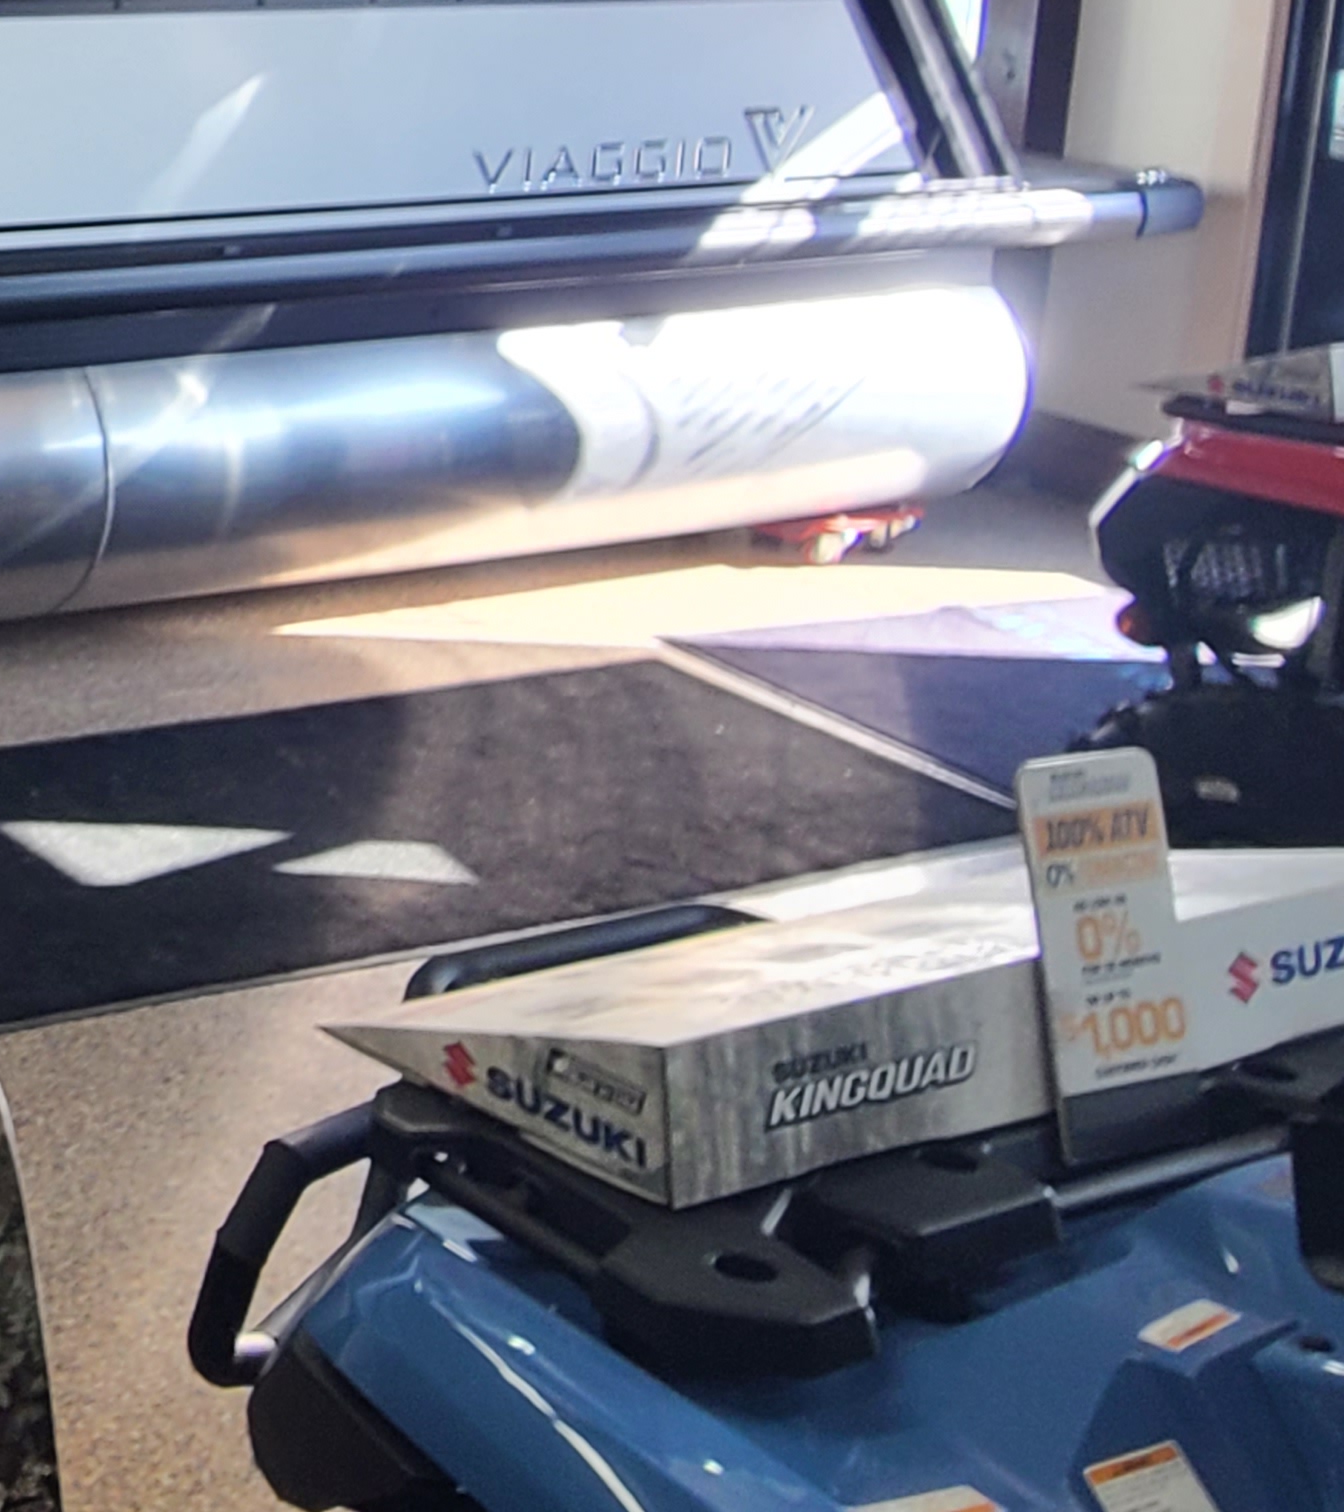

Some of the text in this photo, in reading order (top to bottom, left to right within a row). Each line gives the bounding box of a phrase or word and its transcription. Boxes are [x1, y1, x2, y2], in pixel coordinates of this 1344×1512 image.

[473, 135, 732, 193] VIAGGIO
[1076, 909, 1140, 962] 0%
[764, 1040, 979, 1134] KINGQUAD
[770, 1042, 869, 1083] SUZUKI
[486, 1065, 648, 1170] SUZUKI
